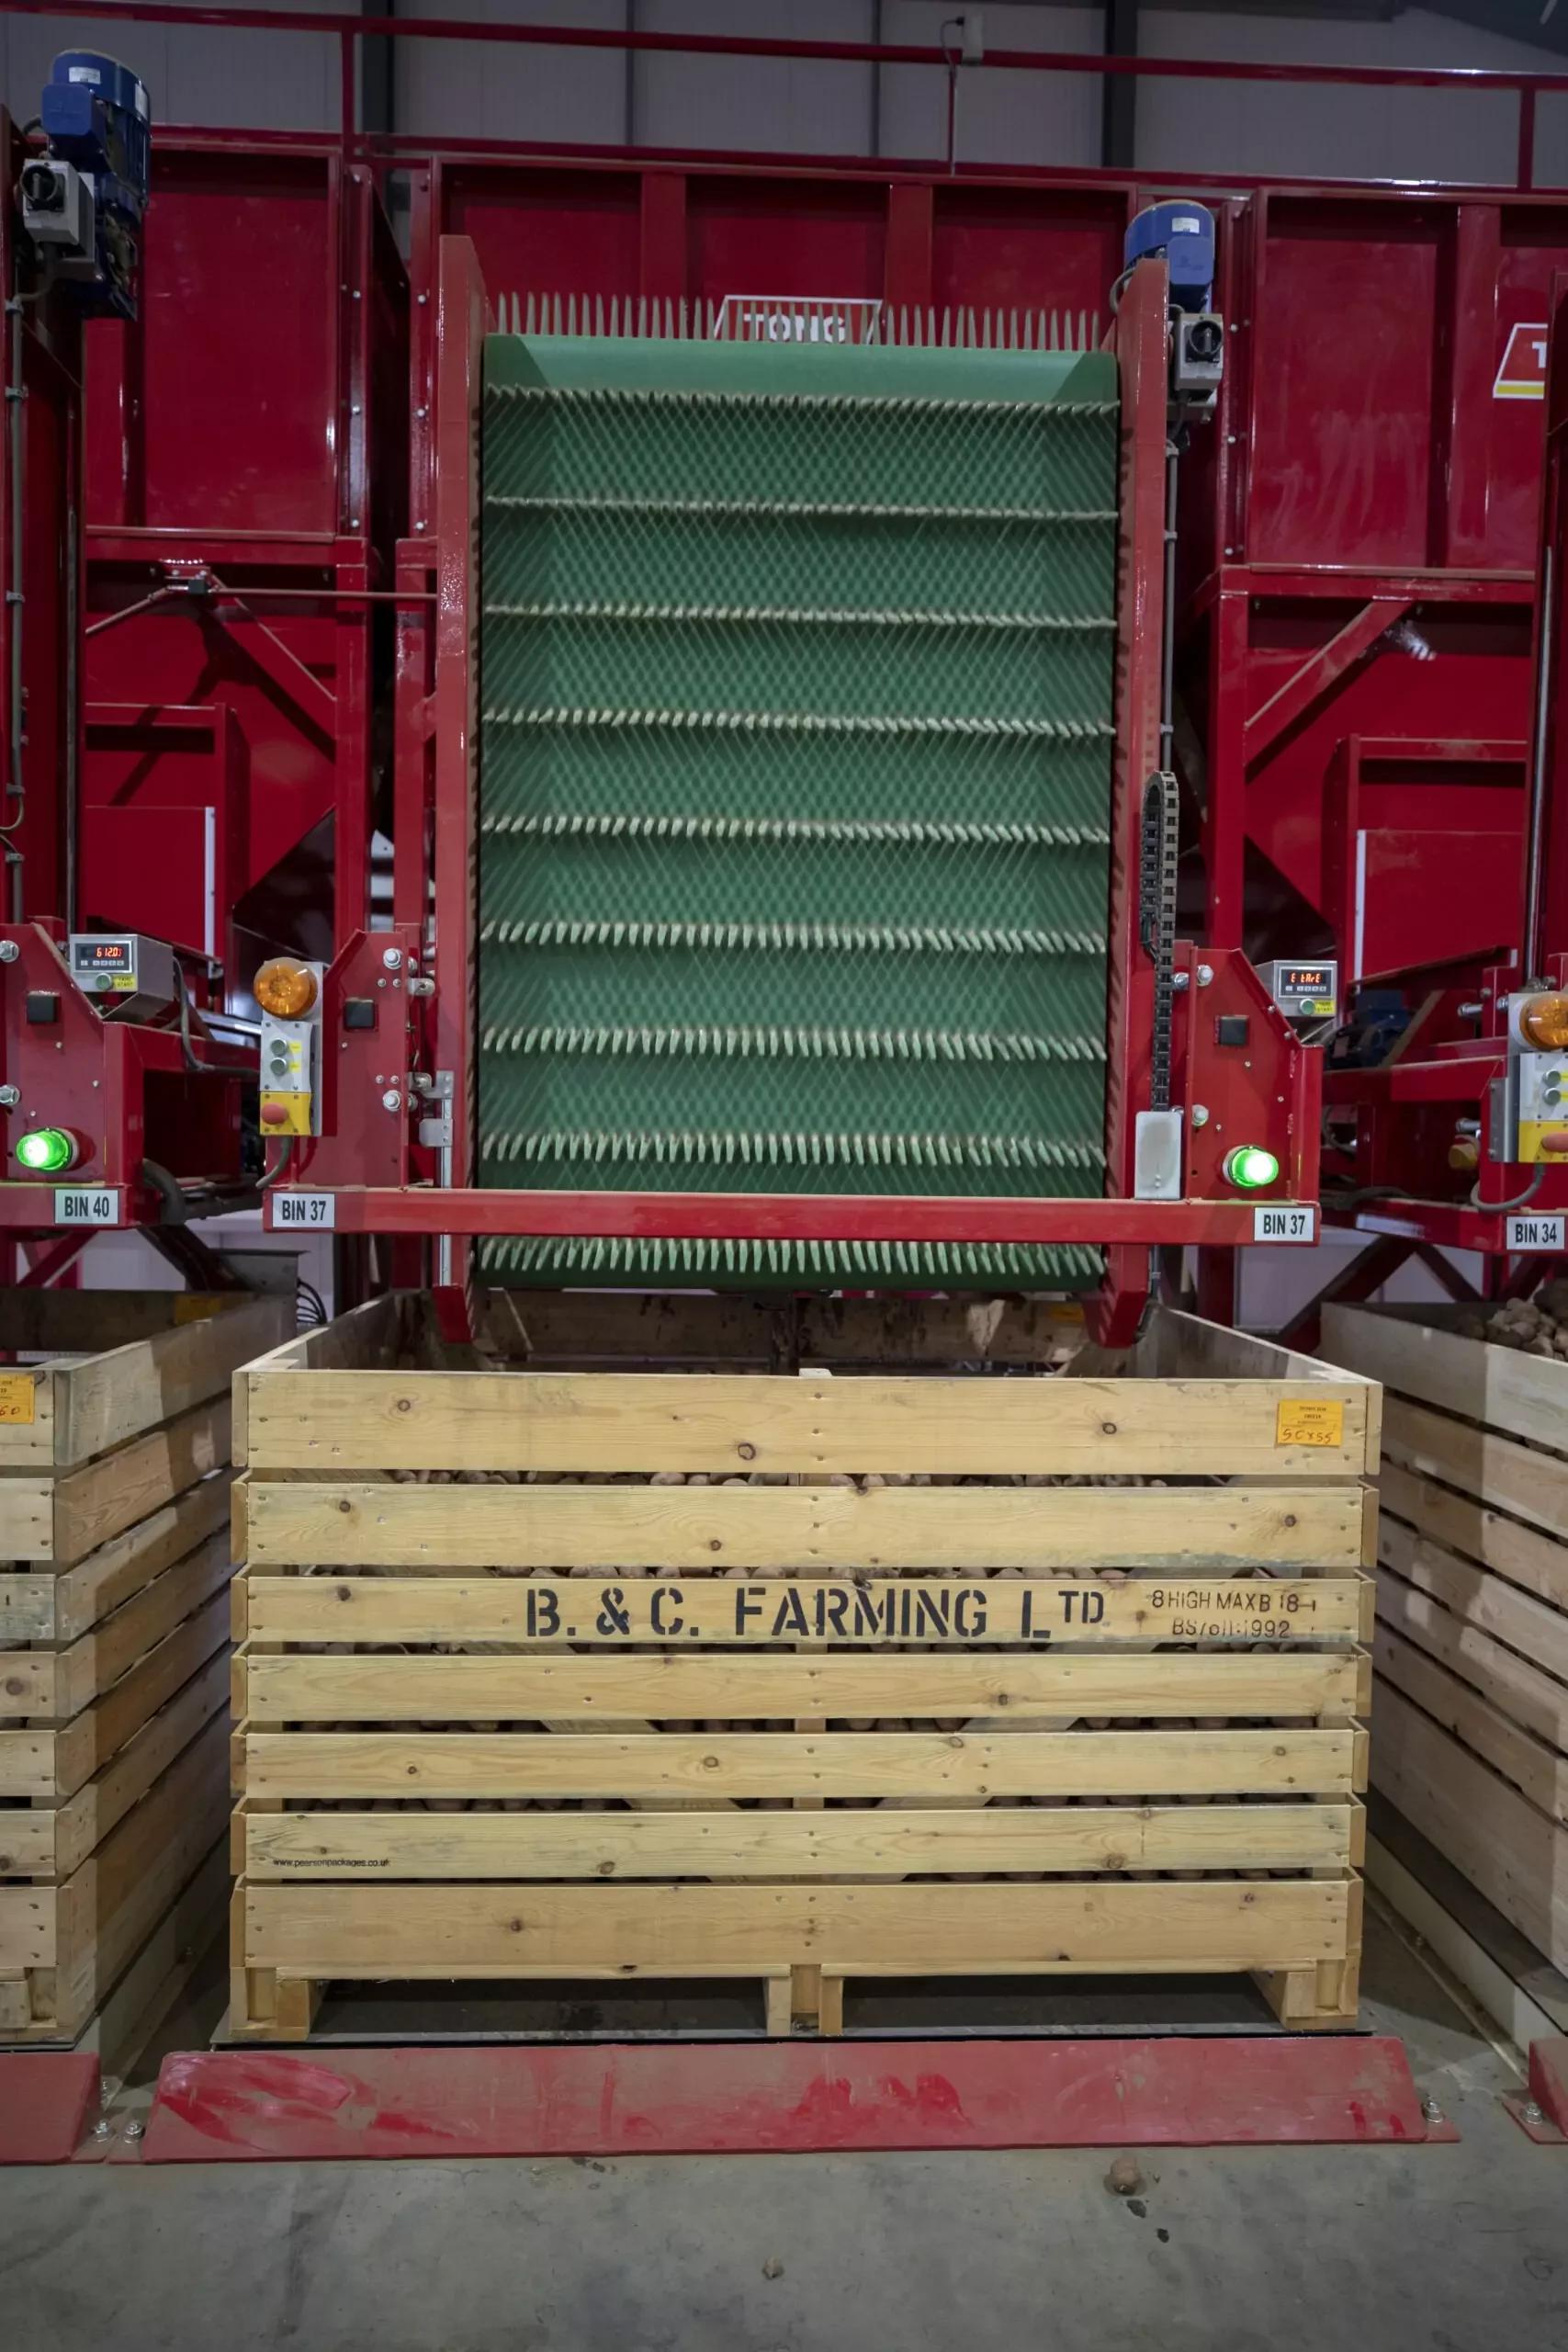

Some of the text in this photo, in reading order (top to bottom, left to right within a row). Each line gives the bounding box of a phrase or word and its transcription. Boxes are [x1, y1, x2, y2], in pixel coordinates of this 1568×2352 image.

[64, 1196, 109, 1217] BIN 40
[282, 1200, 326, 1221] BIN 37
[1263, 1214, 1305, 1235] BIN 37
[1516, 1223, 1557, 1243] BIN 34
[526, 1587, 1104, 1638] B. & C. FARMING LTD
